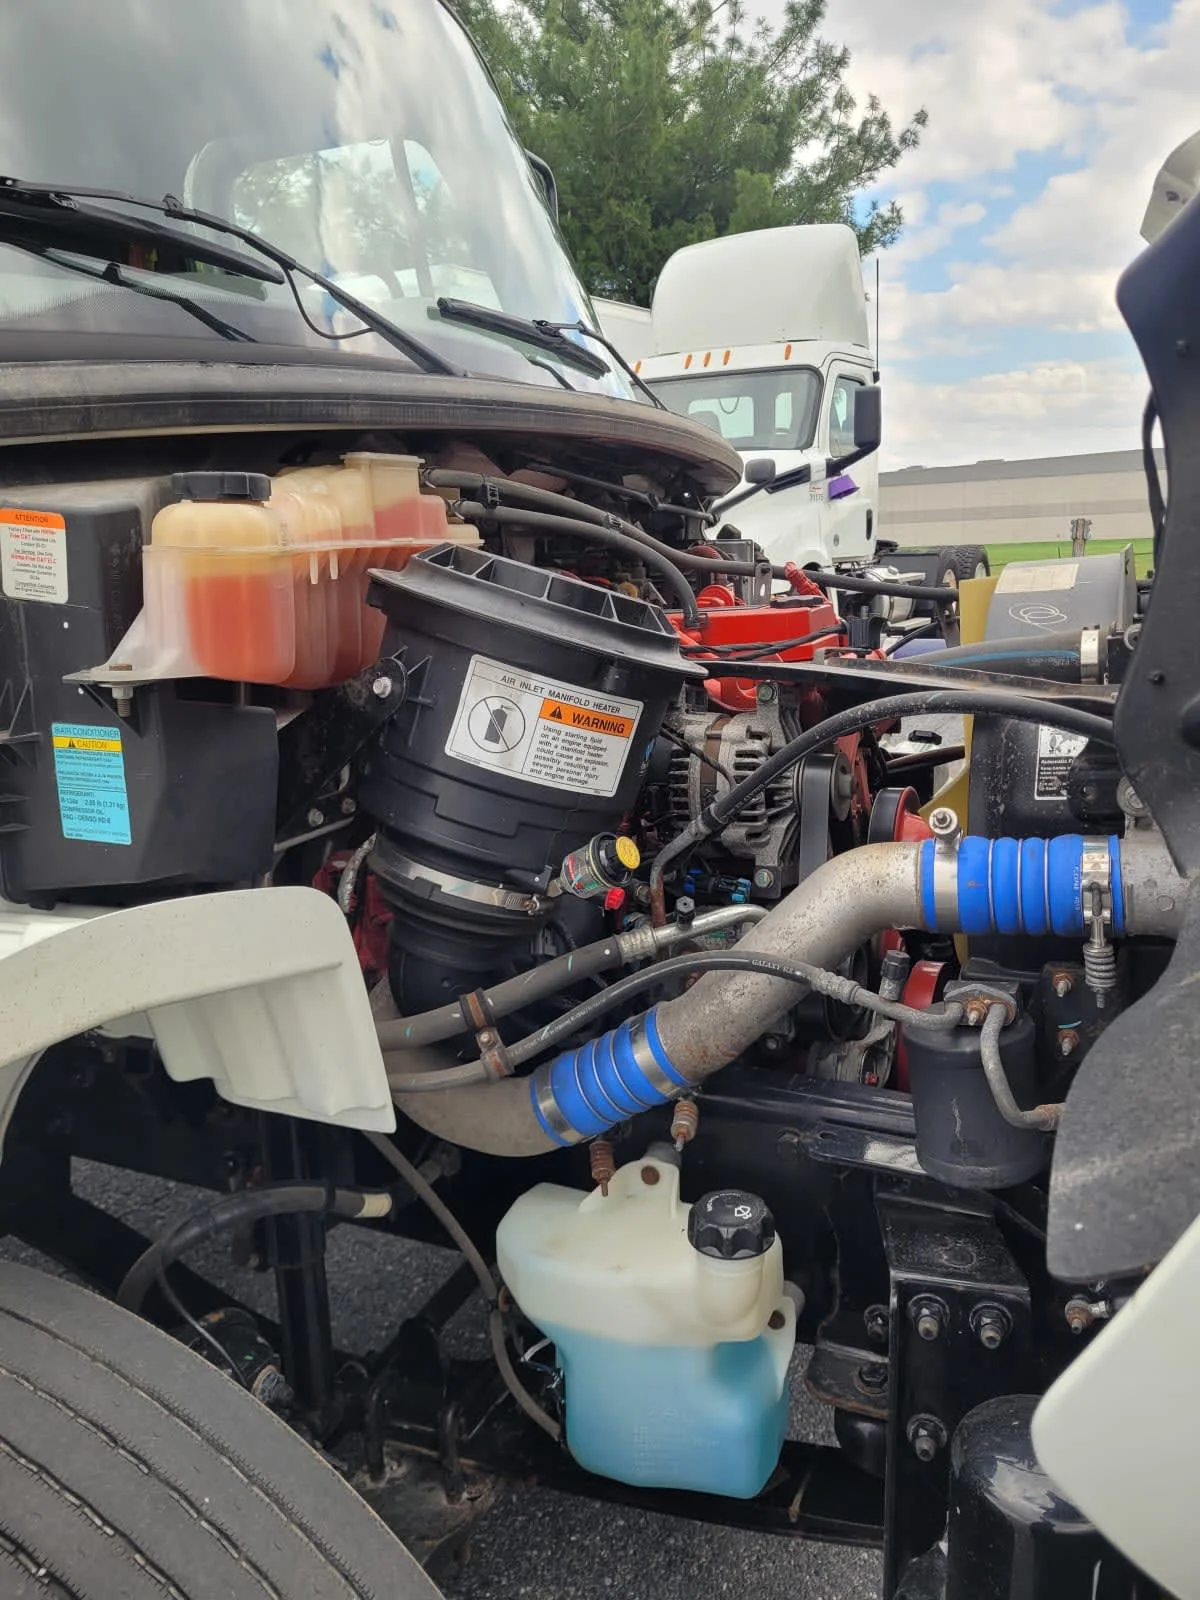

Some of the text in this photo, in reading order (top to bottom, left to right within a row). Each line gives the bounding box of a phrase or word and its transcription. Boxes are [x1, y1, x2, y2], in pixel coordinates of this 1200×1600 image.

[15, 514, 48, 523] ATTENTION
[501, 675, 621, 714] AIR INLET MANIFOLD HEATER
[572, 712, 625, 734] WARNING
[72, 728, 120, 738] CONDITIONER
[543, 725, 562, 736] Using
[565, 731, 588, 742] starting
[77, 740, 108, 749] CAUTION
[562, 739, 582, 747] engine
[584, 744, 608, 752] equipped
[536, 747, 554, 755] could
[560, 746, 586, 755] manifold
[534, 754, 560, 764] possibly
[564, 761, 589, 772] resulting
[532, 761, 599, 780] severe personal injury
[544, 771, 564, 780] engine
